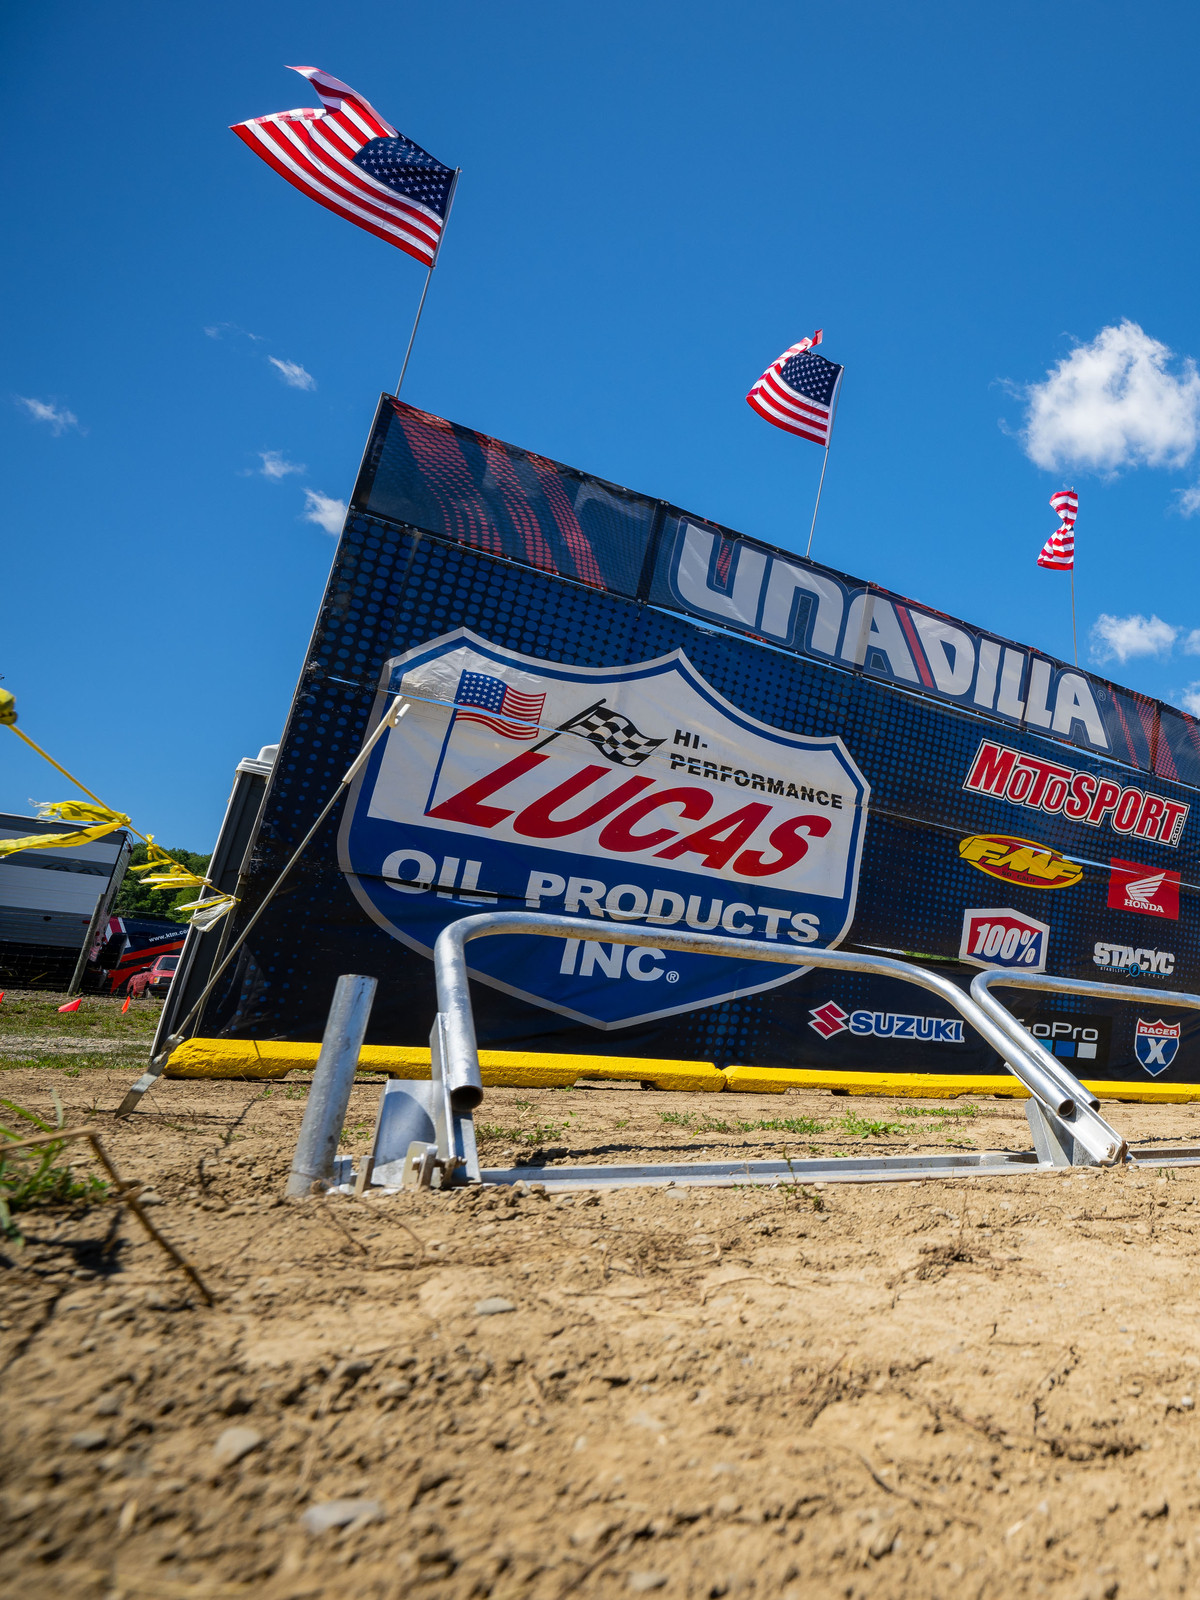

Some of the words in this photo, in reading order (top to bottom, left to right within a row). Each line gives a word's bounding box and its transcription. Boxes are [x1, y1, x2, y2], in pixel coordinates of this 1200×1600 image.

[672, 518, 1110, 751] UNADILLA
[673, 729, 708, 751] HI-
[670, 754, 844, 810] PERFORMANCE
[425, 750, 833, 877] LUCAS
[959, 838, 1083, 881] FMF
[381, 849, 498, 904] OIL
[525, 870, 820, 943] PRODUCTS
[1124, 899, 1164, 913] HONDA
[973, 923, 1037, 964] 100%
[1093, 941, 1175, 974] STACYC
[848, 1009, 965, 1043] SUZUKI
[1017, 1019, 1098, 1041] oPro
[1140, 1026, 1177, 1036] RACER
[1144, 1038, 1168, 1064] X
